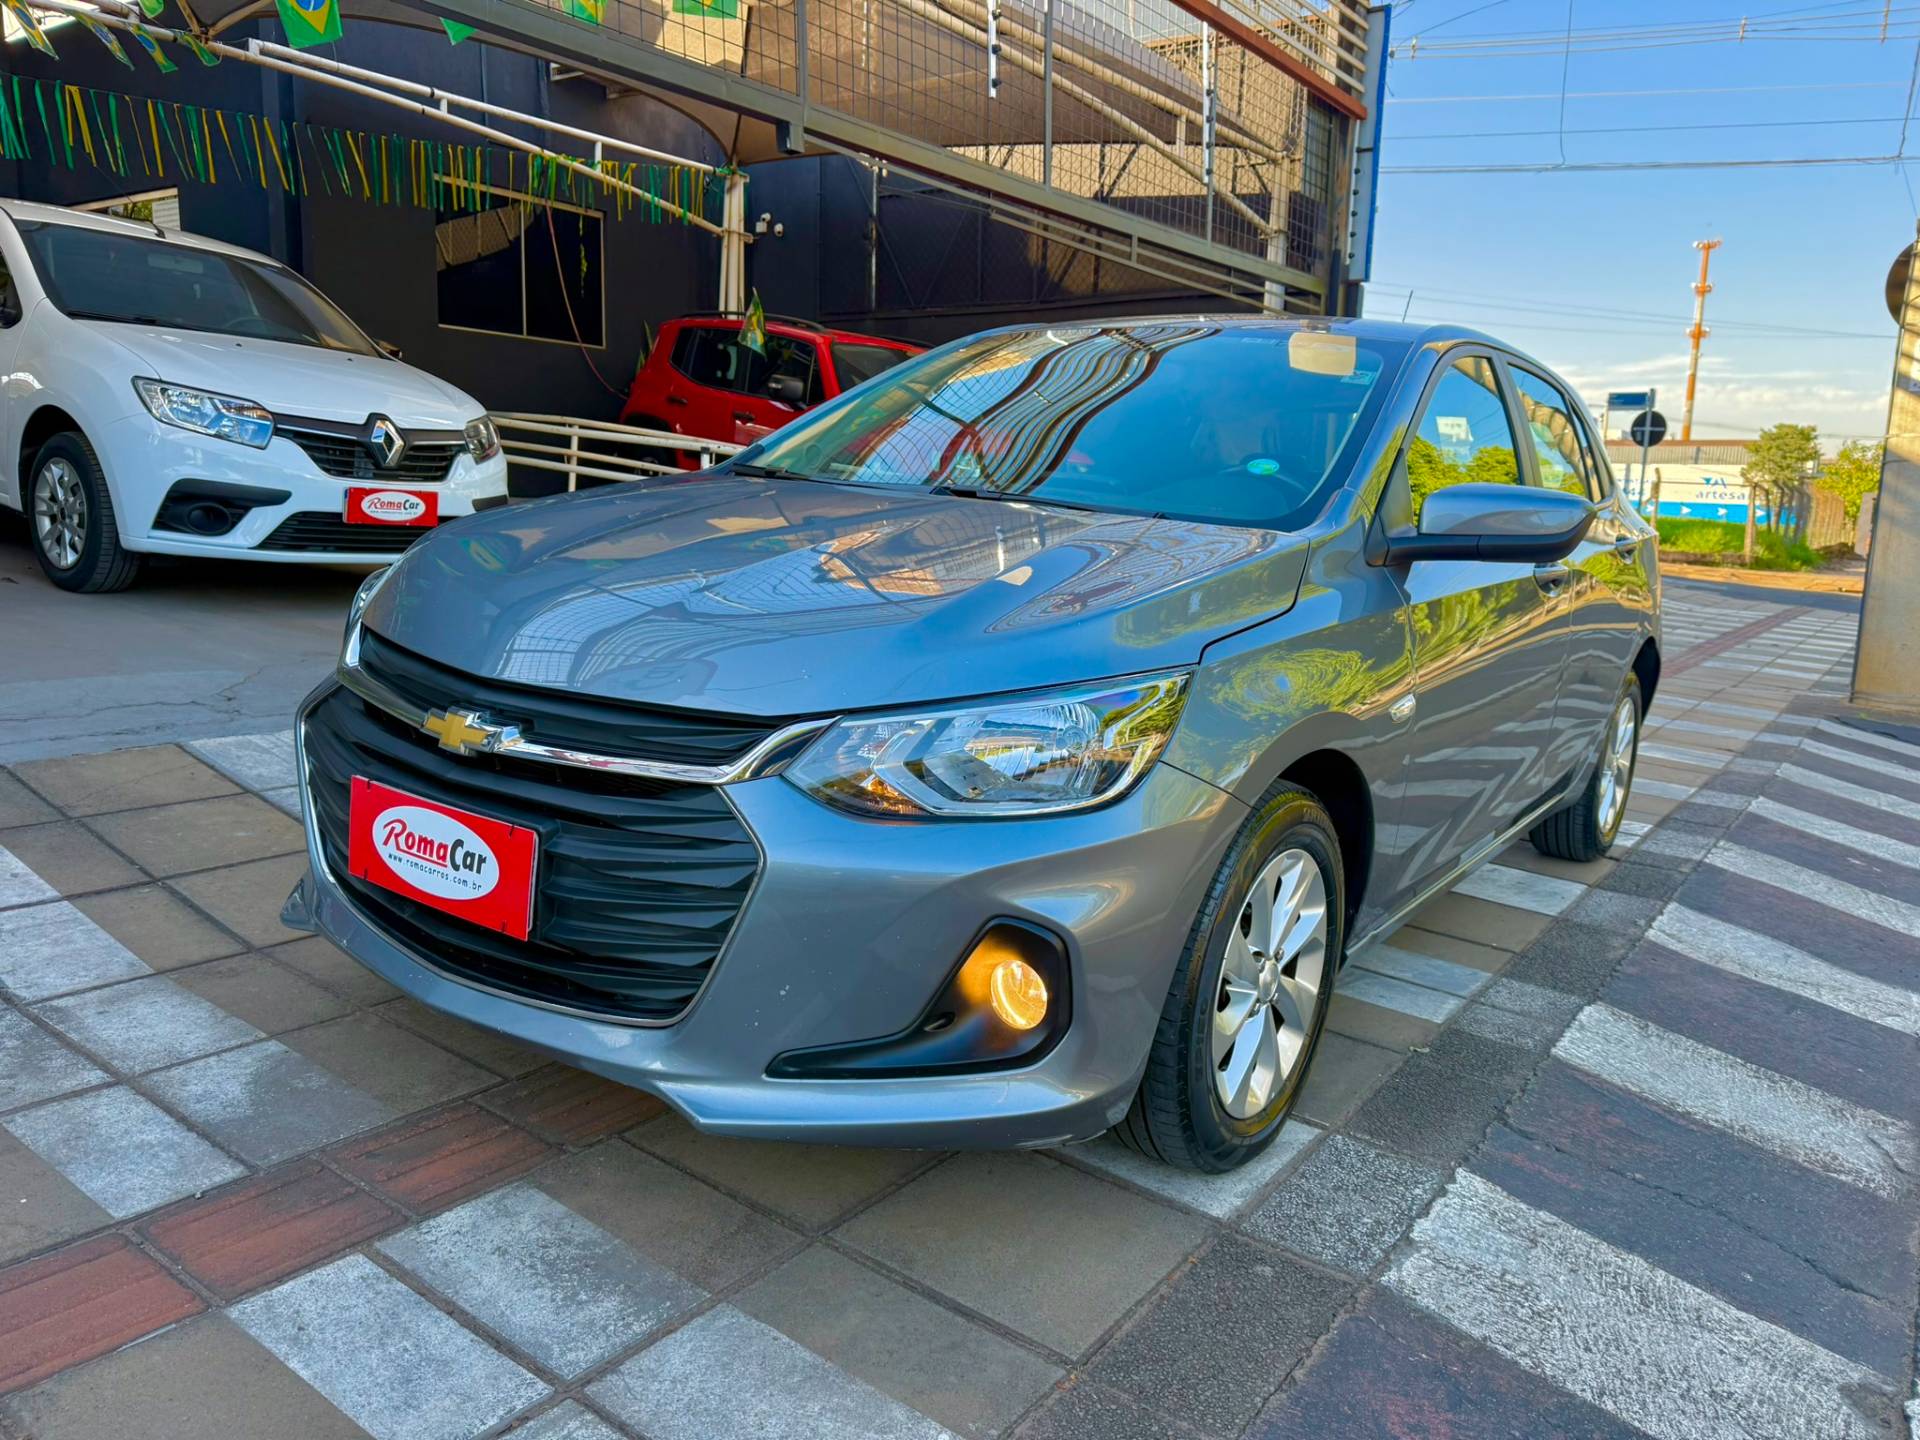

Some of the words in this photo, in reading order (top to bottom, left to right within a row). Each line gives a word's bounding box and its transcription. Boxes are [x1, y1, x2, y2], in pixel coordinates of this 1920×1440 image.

[368, 497, 420, 511] RomaCar
[382, 818, 487, 875] RomaCar
[388, 853, 482, 892] www.romacarros.com.br
